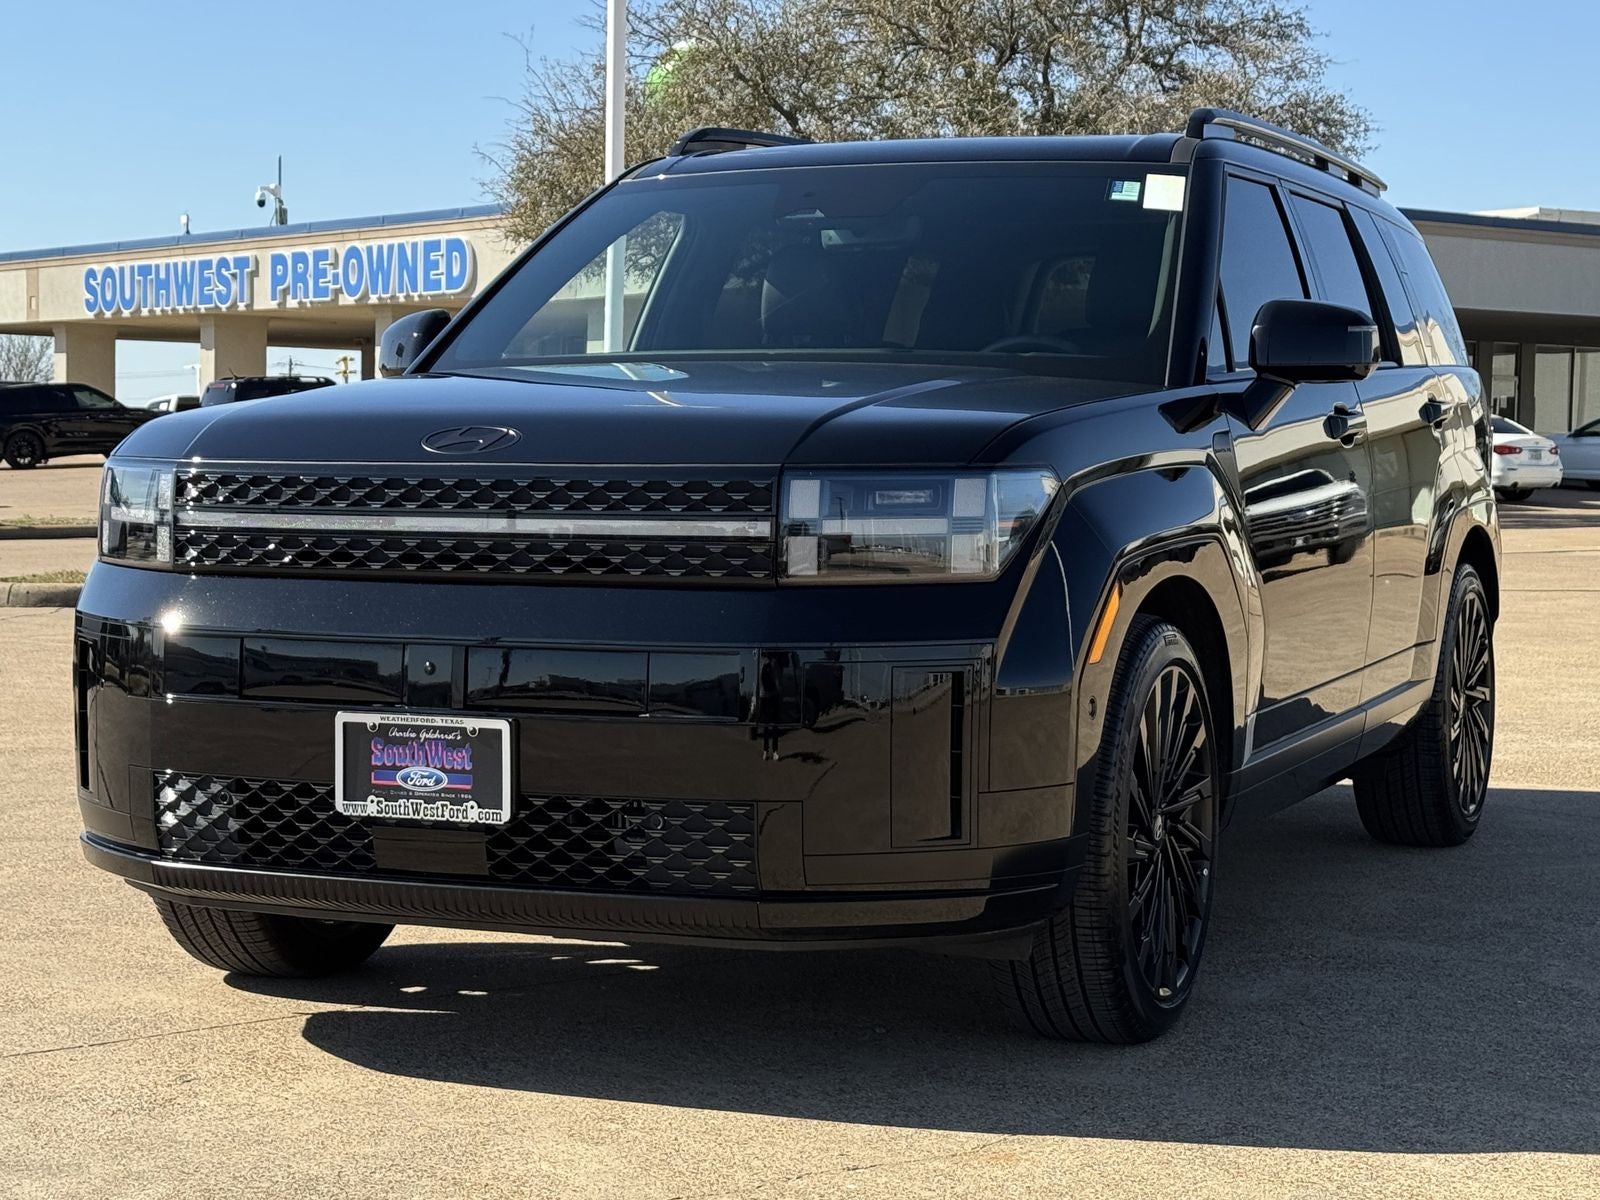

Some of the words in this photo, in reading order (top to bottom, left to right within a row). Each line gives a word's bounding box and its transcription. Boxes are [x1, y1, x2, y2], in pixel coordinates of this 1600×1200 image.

[83, 254, 252, 314] SOUTHWEST
[269, 237, 472, 303] PRE-OWNED
[371, 737, 473, 770] SouthWest
[407, 771, 437, 787] Ford
[341, 800, 503, 822] www.SouthWestFord.com
